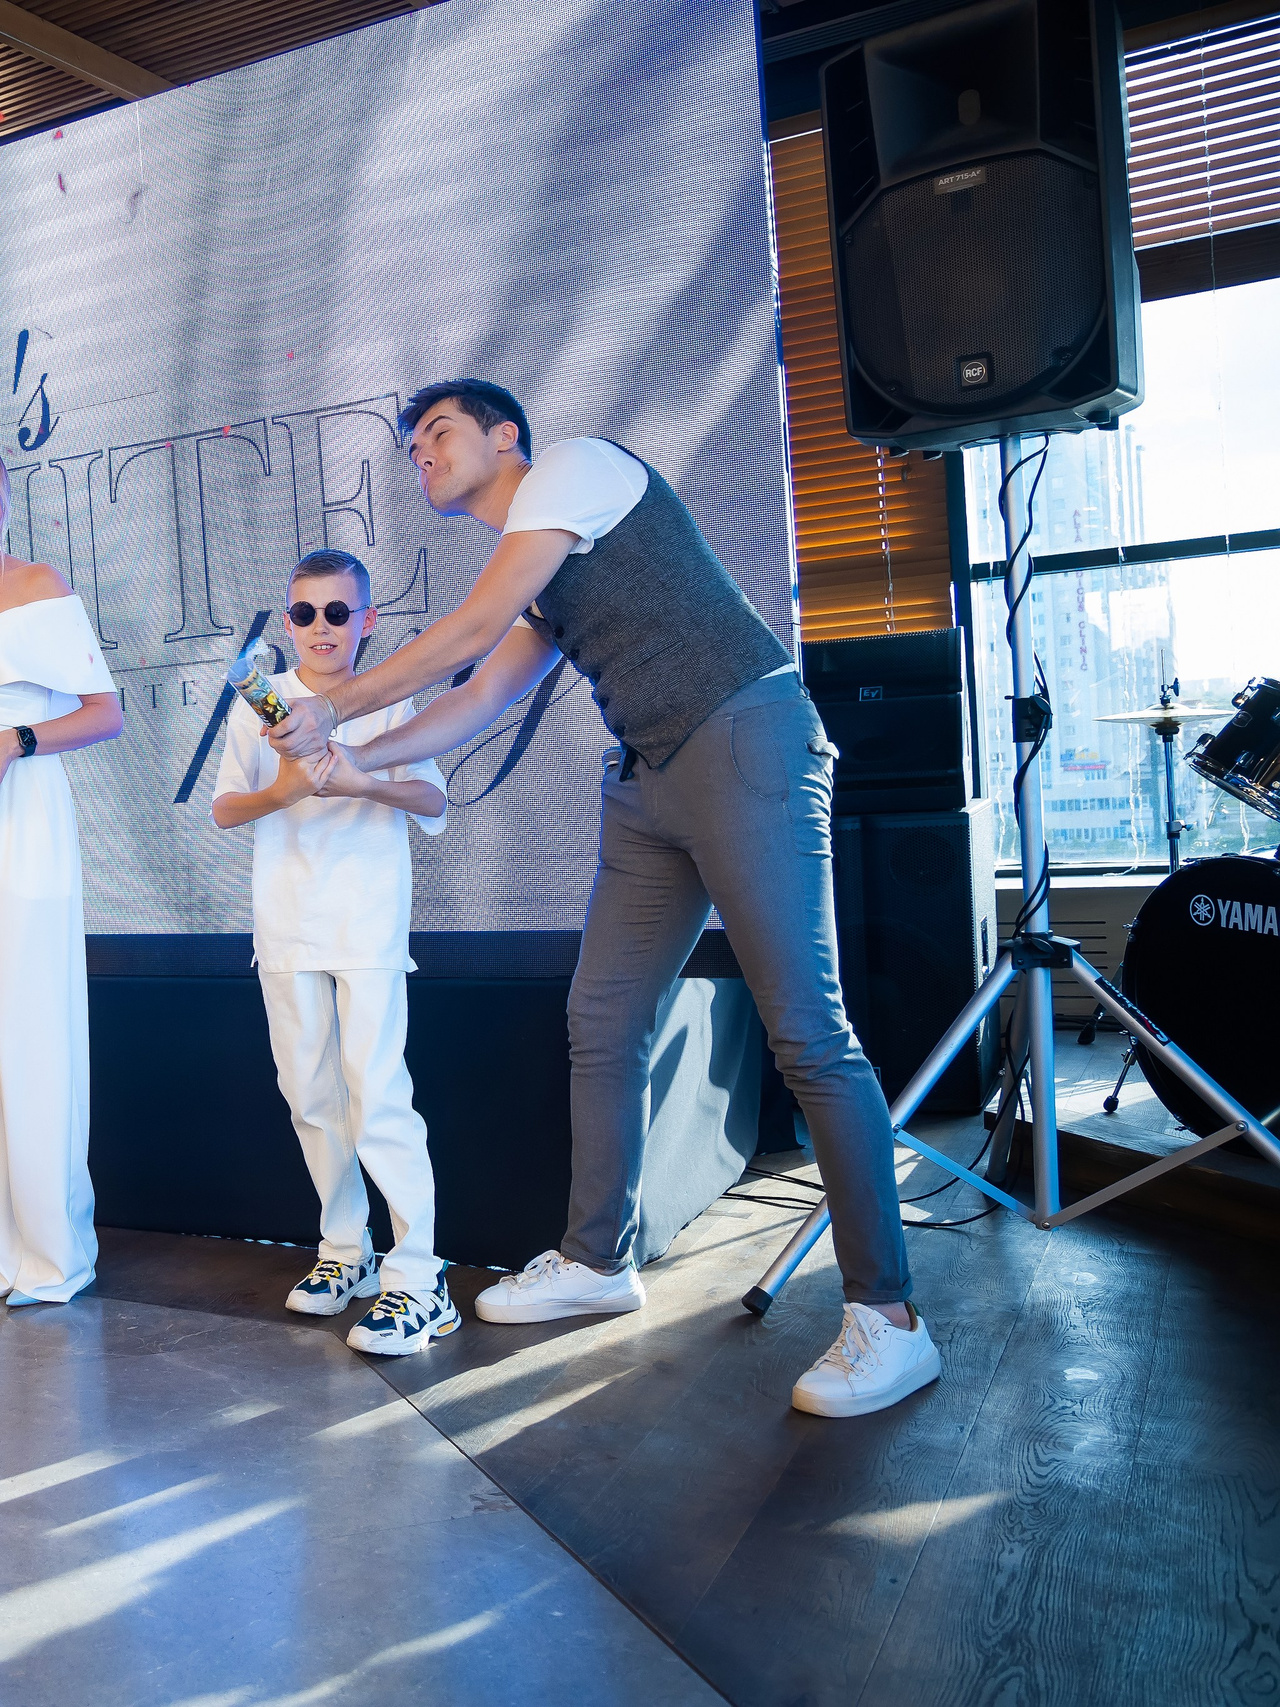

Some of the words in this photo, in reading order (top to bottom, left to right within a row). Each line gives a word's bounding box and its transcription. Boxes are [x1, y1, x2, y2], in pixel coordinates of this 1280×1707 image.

[938, 176, 955, 186] ART
[965, 366, 983, 378] RCF
[1078, 621, 1088, 671] CLINIC
[120, 680, 198, 712] ITE
[863, 689, 880, 698] EV
[1217, 898, 1279, 937] YAMA
